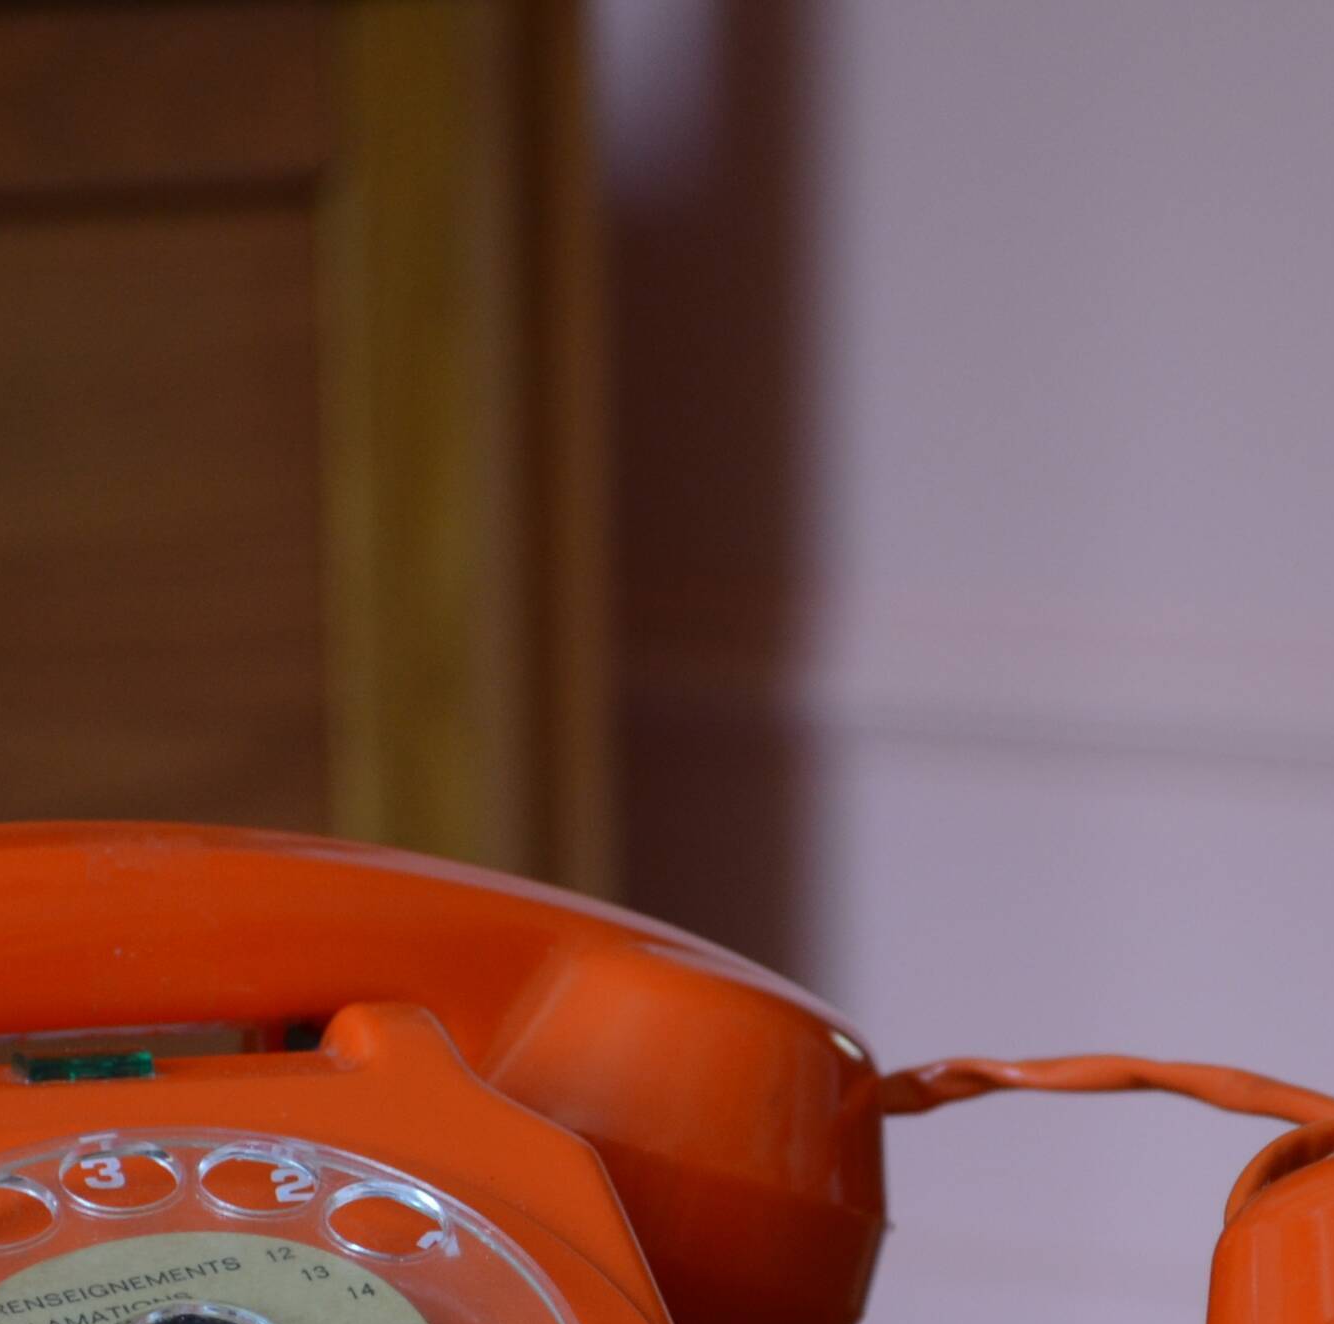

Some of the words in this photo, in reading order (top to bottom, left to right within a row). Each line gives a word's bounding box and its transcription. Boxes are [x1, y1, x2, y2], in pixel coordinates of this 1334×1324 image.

[80, 1157, 125, 1190] 3
[271, 1168, 315, 1203] 2
[267, 1246, 296, 1263] 12
[301, 1265, 330, 1282] 13
[347, 1283, 376, 1300] 14
